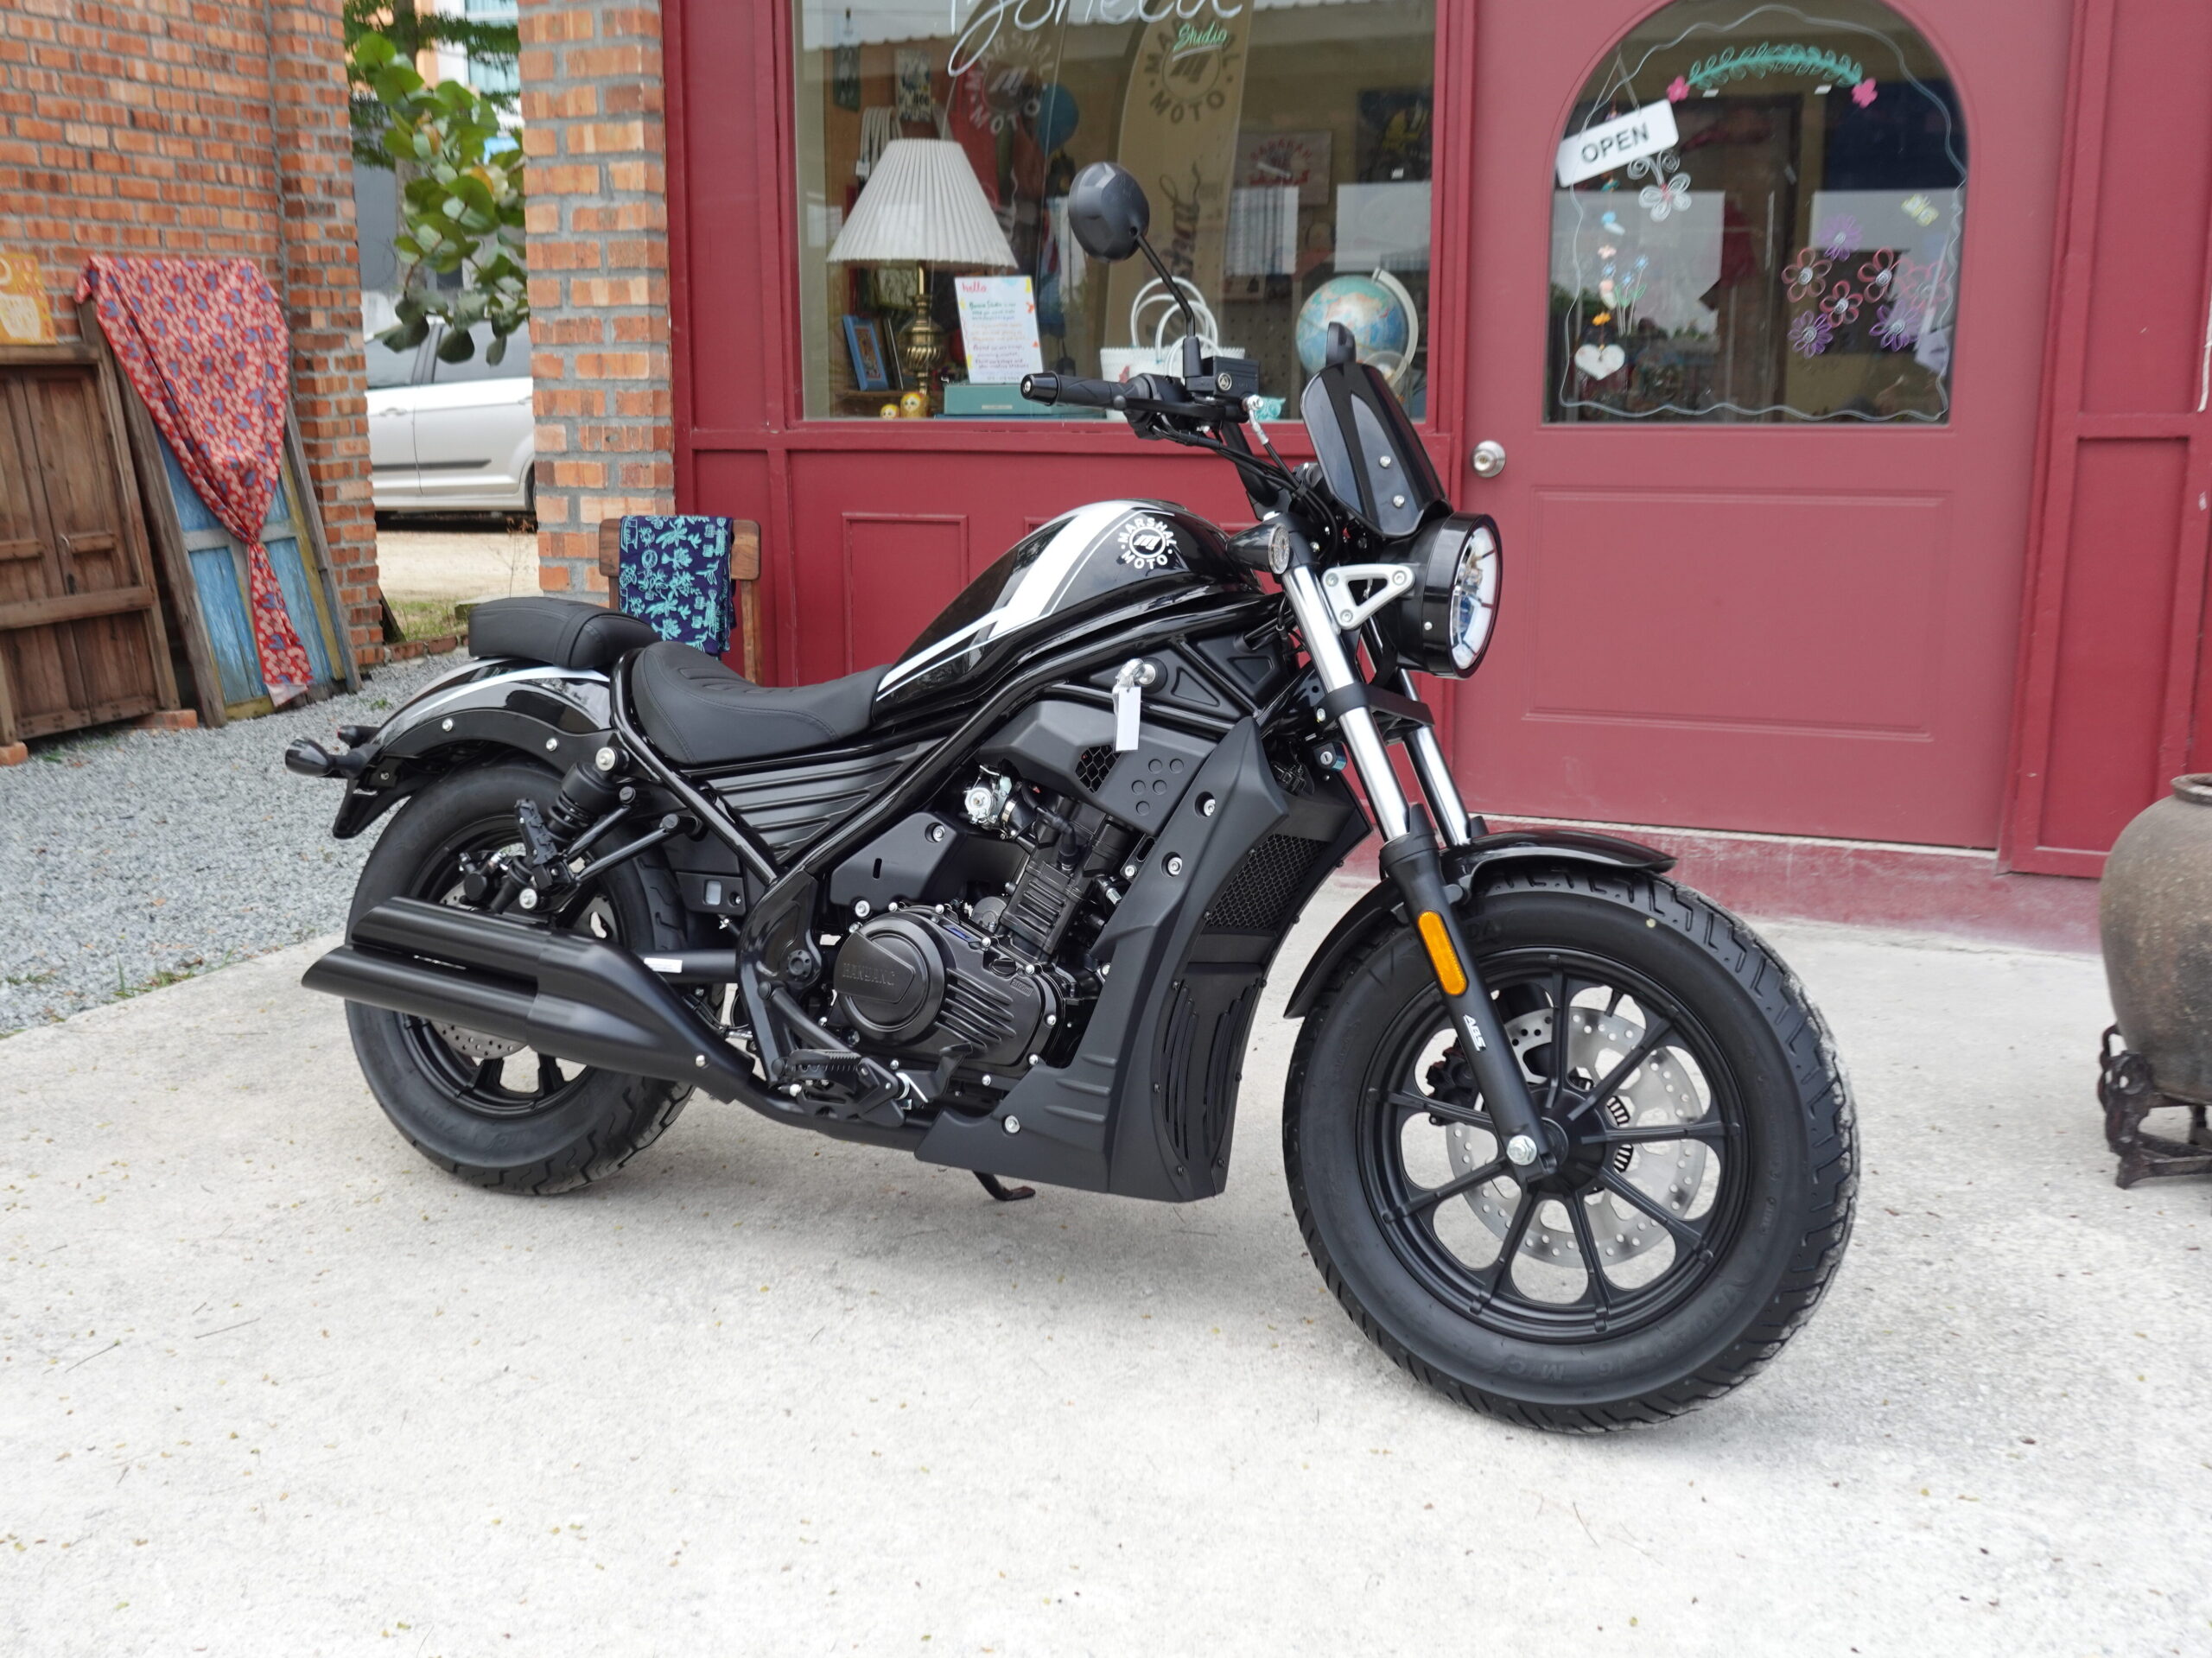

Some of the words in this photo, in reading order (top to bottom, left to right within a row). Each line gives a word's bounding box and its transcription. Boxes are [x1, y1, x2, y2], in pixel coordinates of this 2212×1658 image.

[1172, 20, 1229, 54] Studio
[969, 97, 1042, 135] MOTO
[1150, 90, 1226, 124] MOTO
[1581, 122, 1650, 164] OPEN
[961, 280, 987, 294] hello
[1117, 517, 1178, 547] MARSHAL
[1121, 549, 1169, 570] MOTO
[1462, 1013, 1488, 1052] ABS
